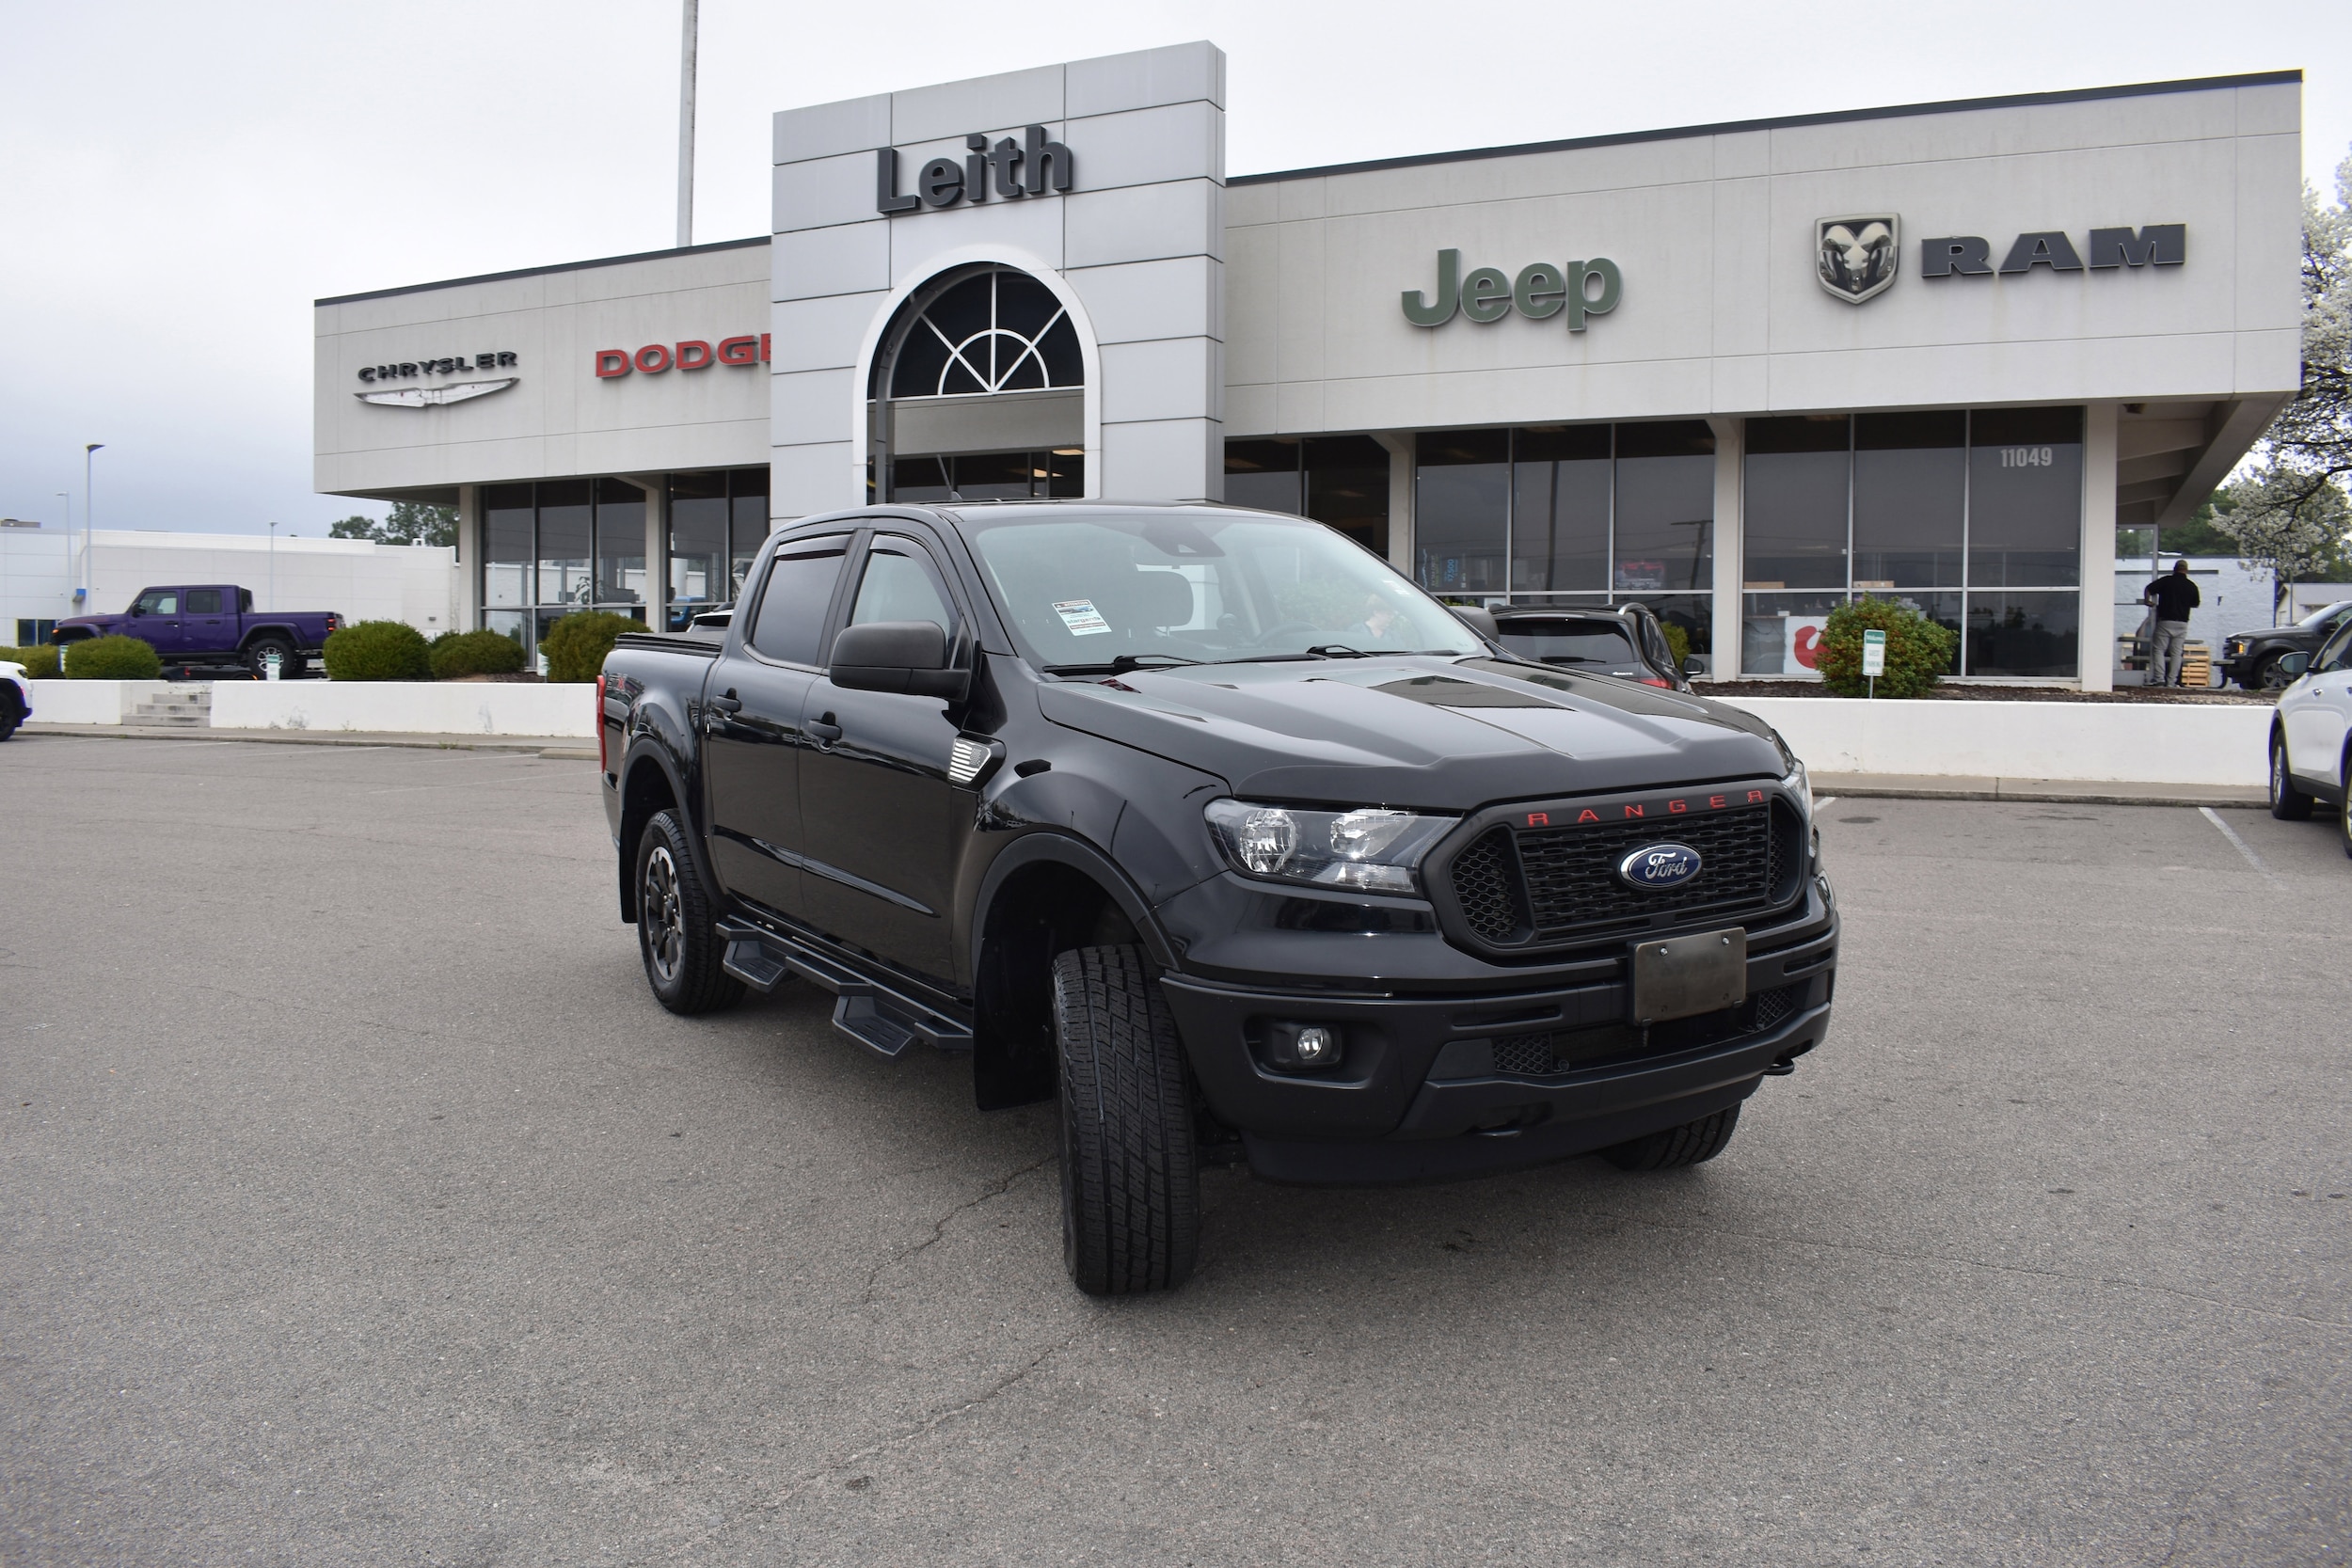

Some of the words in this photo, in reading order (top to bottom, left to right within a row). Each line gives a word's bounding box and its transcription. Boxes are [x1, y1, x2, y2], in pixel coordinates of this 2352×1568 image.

[877, 124, 1073, 214] Leith
[1921, 223, 2186, 277] RAM
[1401, 248, 1624, 332] Jeep
[358, 351, 518, 383] CHRYSLER
[2000, 447, 2053, 467] 11049
[1528, 790, 1764, 827] RANGER
[1645, 852, 1688, 879] Ford
